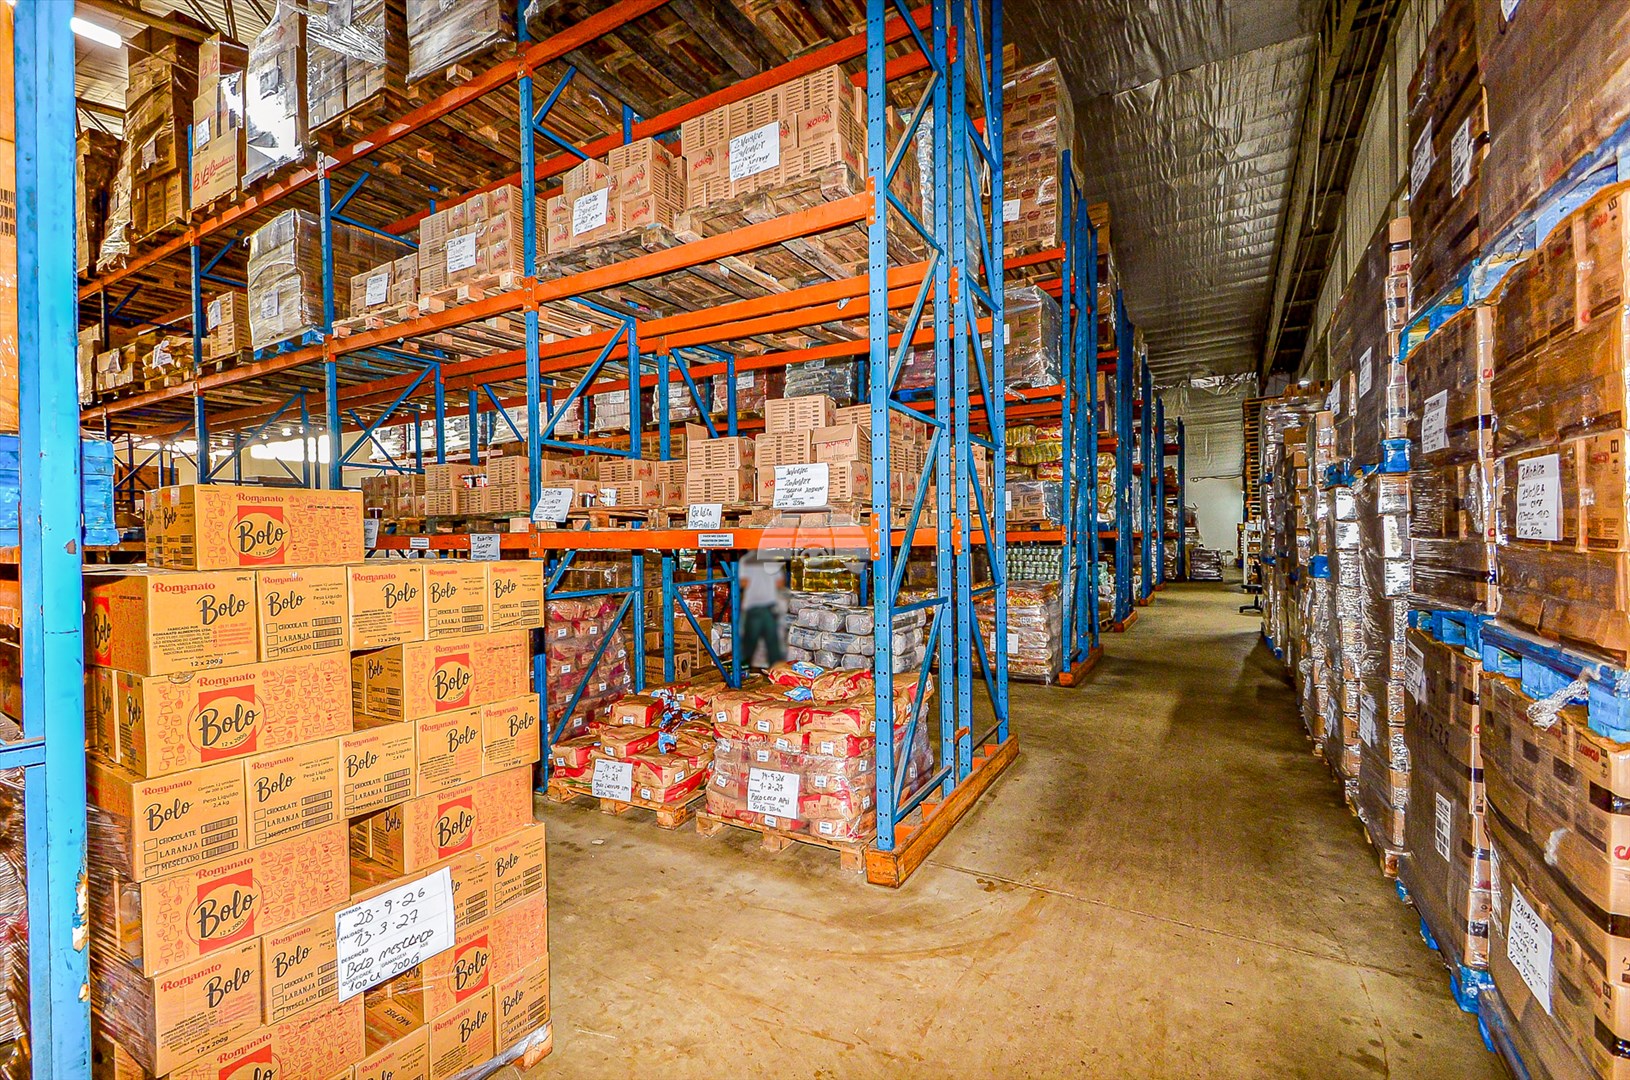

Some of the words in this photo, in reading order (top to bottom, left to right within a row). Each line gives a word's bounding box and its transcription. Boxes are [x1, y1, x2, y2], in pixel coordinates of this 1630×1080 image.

[236, 492, 284, 503] Romanato
[234, 521, 288, 553] Bolo
[266, 546, 277, 554] 200g
[352, 573, 396, 583] Romanato
[429, 568, 458, 577] Romanato
[492, 566, 518, 574] Romanato
[152, 582, 216, 595] Romanato
[381, 582, 419, 609] Bolo
[429, 582, 458, 603] Bolo
[492, 578, 518, 599] Bolo
[196, 593, 250, 625] Bolo
[265, 590, 306, 617] Bolo
[278, 621, 309, 630] CHOCOLATE
[438, 618, 461, 626] LARANJA
[279, 632, 311, 643] LARANJA
[280, 645, 312, 654] MESCLADO
[434, 643, 470, 653] Romanato
[367, 658, 384, 680] Bolo
[196, 672, 256, 688] Romanato
[432, 667, 473, 700] Bolo
[484, 706, 519, 718] Romanato
[194, 703, 261, 746] Bolo
[419, 719, 458, 732] Romanato
[506, 712, 536, 738] Bolo
[234, 732, 247, 743] 200g
[342, 736, 379, 748] Romanato
[445, 725, 479, 753] Bolo
[251, 756, 294, 770] Romanato
[343, 750, 380, 778] Bolo
[142, 779, 193, 796] Romanato
[253, 772, 297, 803] Bolo
[354, 778, 382, 790] CHOCOLATE
[437, 786, 473, 800] Romanato
[355, 788, 383, 801] LARANJA
[143, 798, 194, 832] Bolo
[266, 801, 298, 815] CHOCOLATE
[267, 813, 300, 828] LARANJA
[384, 809, 402, 833] Bolo
[435, 810, 476, 847] Bolo
[158, 830, 197, 845] CHOCOLATE
[159, 842, 199, 858] LARANJA
[161, 854, 200, 870] MESCLADO
[195, 857, 254, 880] Romanato
[495, 853, 521, 878] Bolo
[193, 889, 259, 939] Bolo
[338, 906, 362, 919] ENTRADA
[232, 918, 245, 930] 200g
[270, 927, 311, 947] Romanato
[340, 928, 364, 942] VALIDADE
[271, 945, 313, 978] Bolo
[341, 948, 369, 964] DESCRIÇÃO
[160, 963, 222, 993] Romanato
[341, 969, 372, 986] QUANTIDADE
[381, 952, 407, 968] GRAMAGEM
[452, 950, 492, 991] Bolo
[202, 967, 255, 1009] Bolo
[284, 971, 314, 990] CHOCOLATE
[284, 983, 316, 1002] LARANJA
[285, 994, 317, 1013] MESCLADO
[501, 989, 525, 1017] Bolo
[433, 1007, 470, 1032] Romanato
[457, 1010, 489, 1044] Bolo
[211, 1035, 229, 1048] 200g
[216, 1032, 272, 1063] Romanato
[361, 1052, 395, 1074] Romanato
